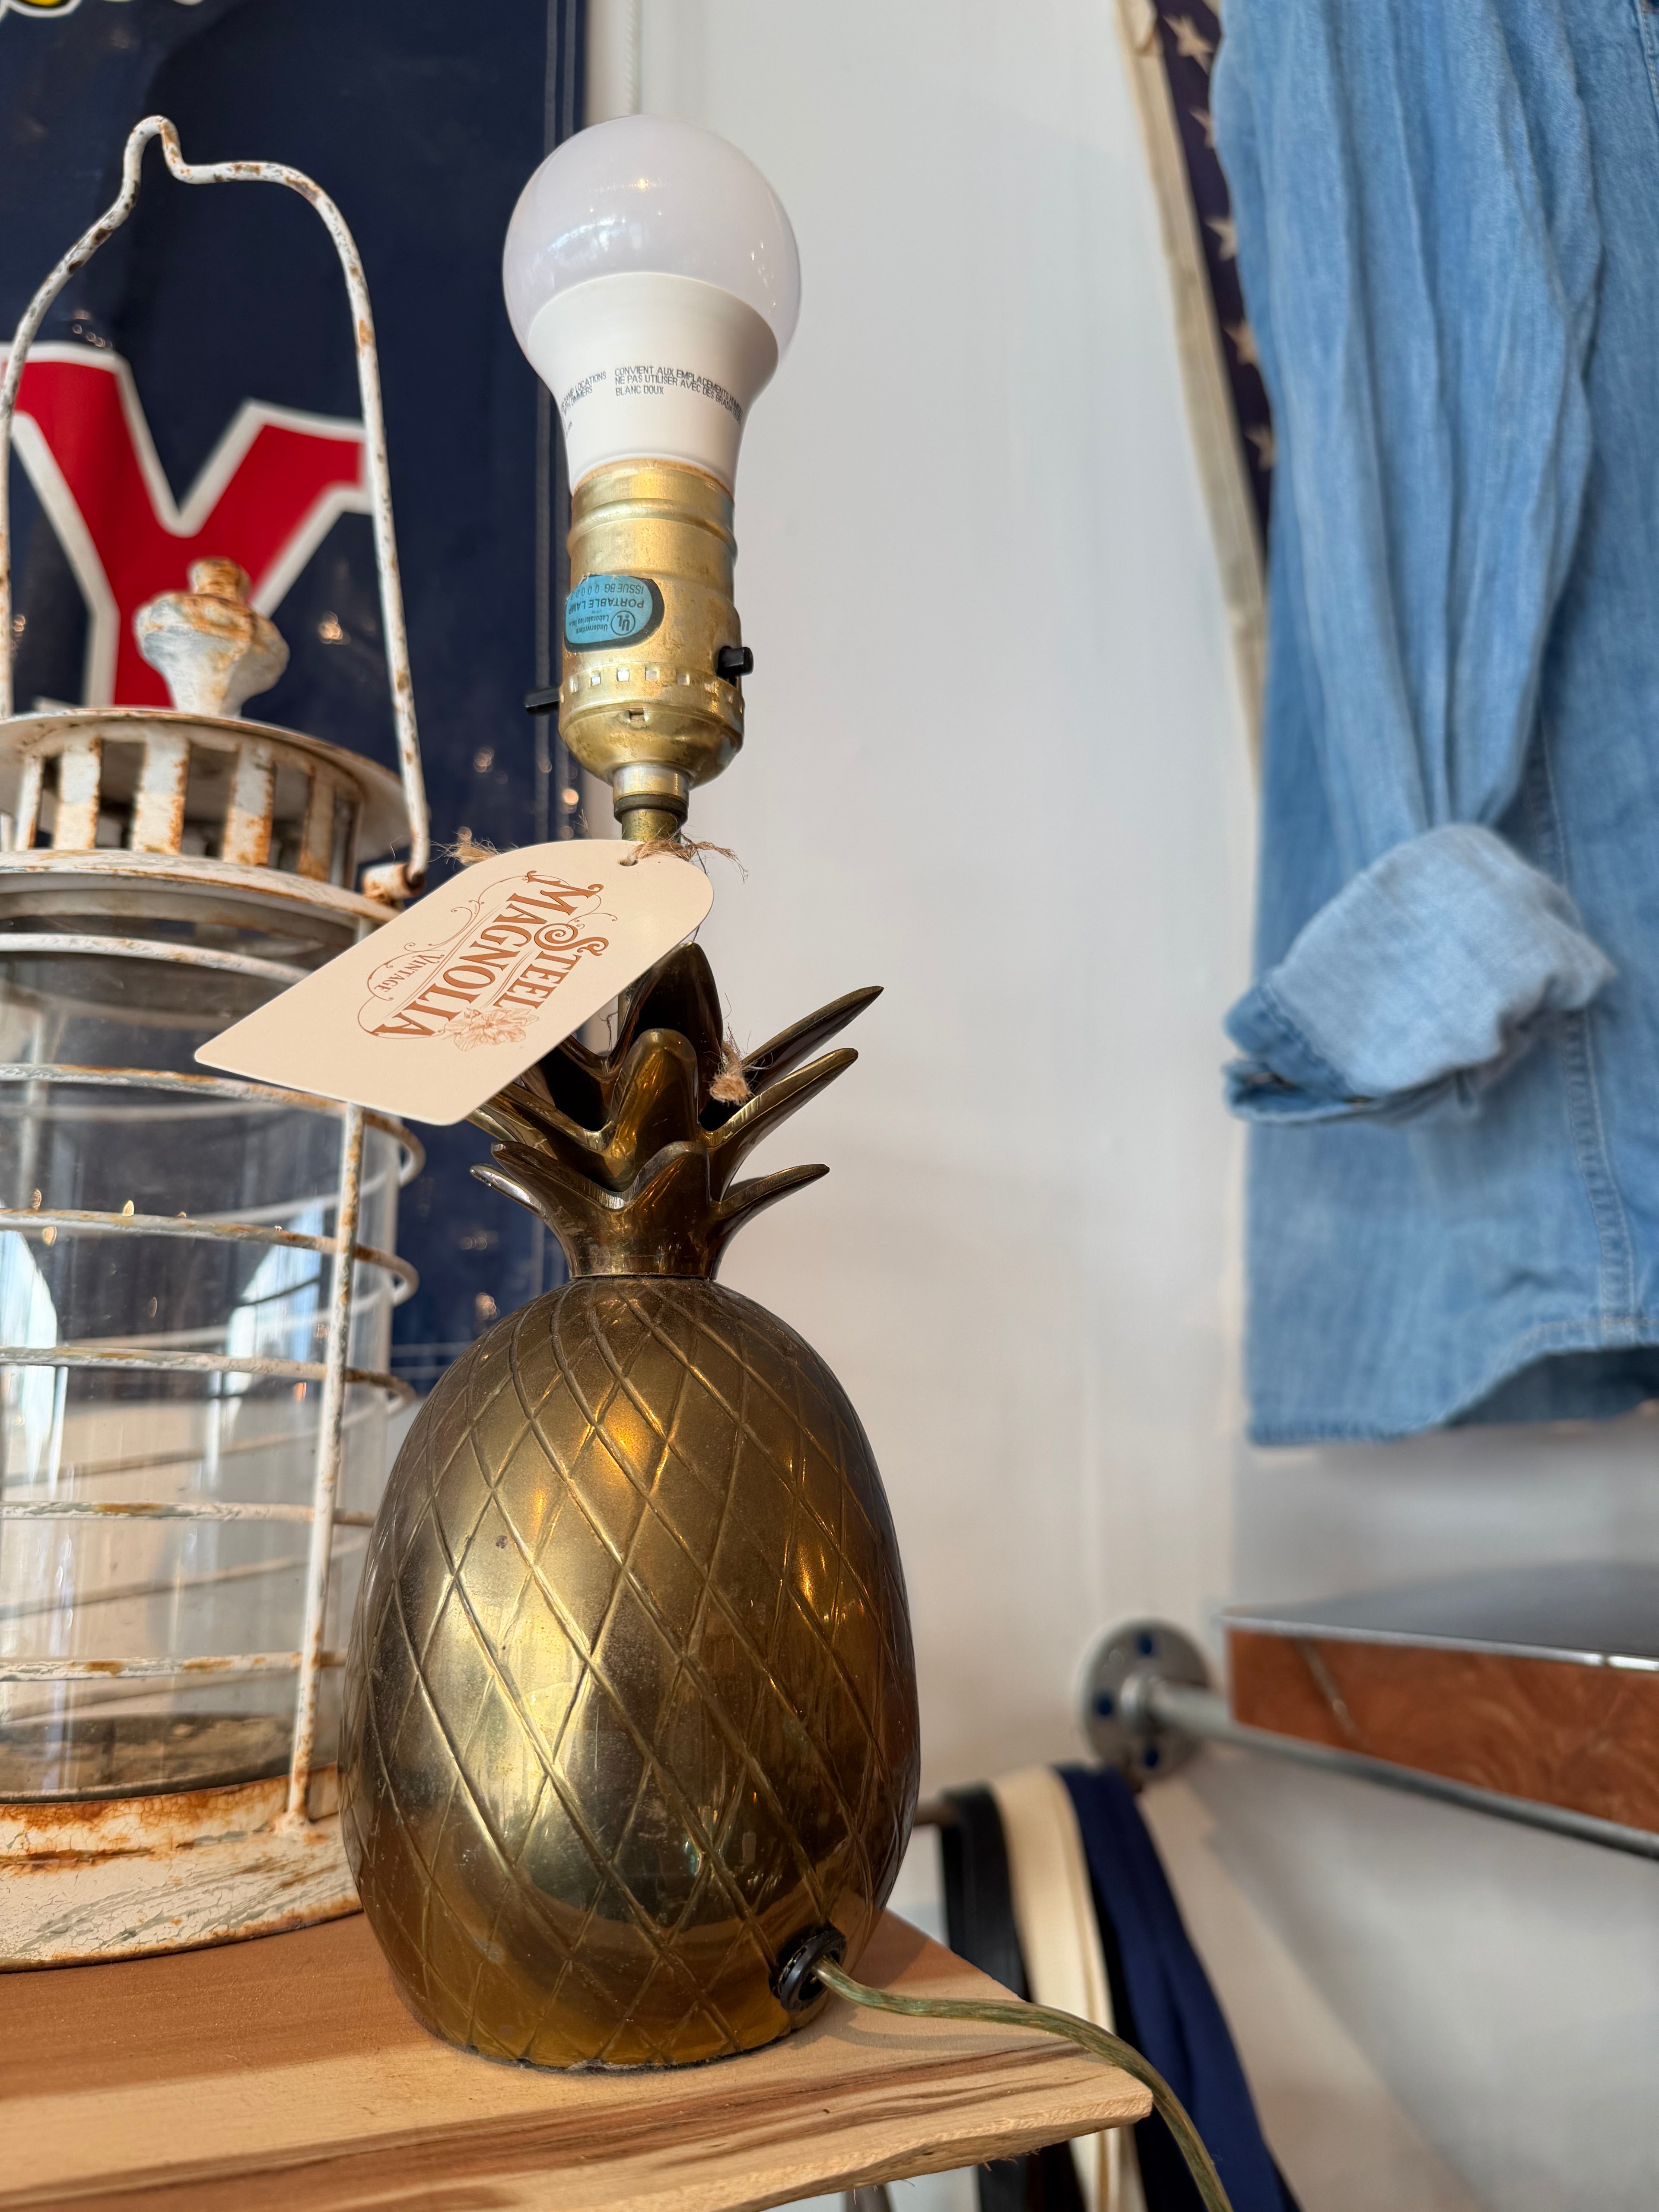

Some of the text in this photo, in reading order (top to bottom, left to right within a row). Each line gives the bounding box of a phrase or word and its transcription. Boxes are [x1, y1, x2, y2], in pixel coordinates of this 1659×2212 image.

[575, 371, 607, 392] LOCATIONS
[615, 365, 654, 376] CONVIENT
[657, 367, 674, 377] AUX
[677, 369, 729, 400] EMPLACEMENTS
[615, 376, 625, 385] NE
[627, 375, 642, 384] PAS
[645, 375, 678, 386] UTILISER
[680, 379, 701, 393] AVEC
[702, 386, 715, 399] DES
[616, 385, 664, 396] BLANC DOUX
[605, 584, 615, 593] BG
[617, 584, 644, 595] ISSUE
[569, 598, 645, 614] PORTABLE LAMP
[578, 615, 609, 623] Laboratories
[576, 623, 608, 634] Underwriters
[372, 870, 604, 1036] MAGNOLIA
[374, 954, 445, 992] VINTAGE
[492, 923, 609, 1009] STEEL
